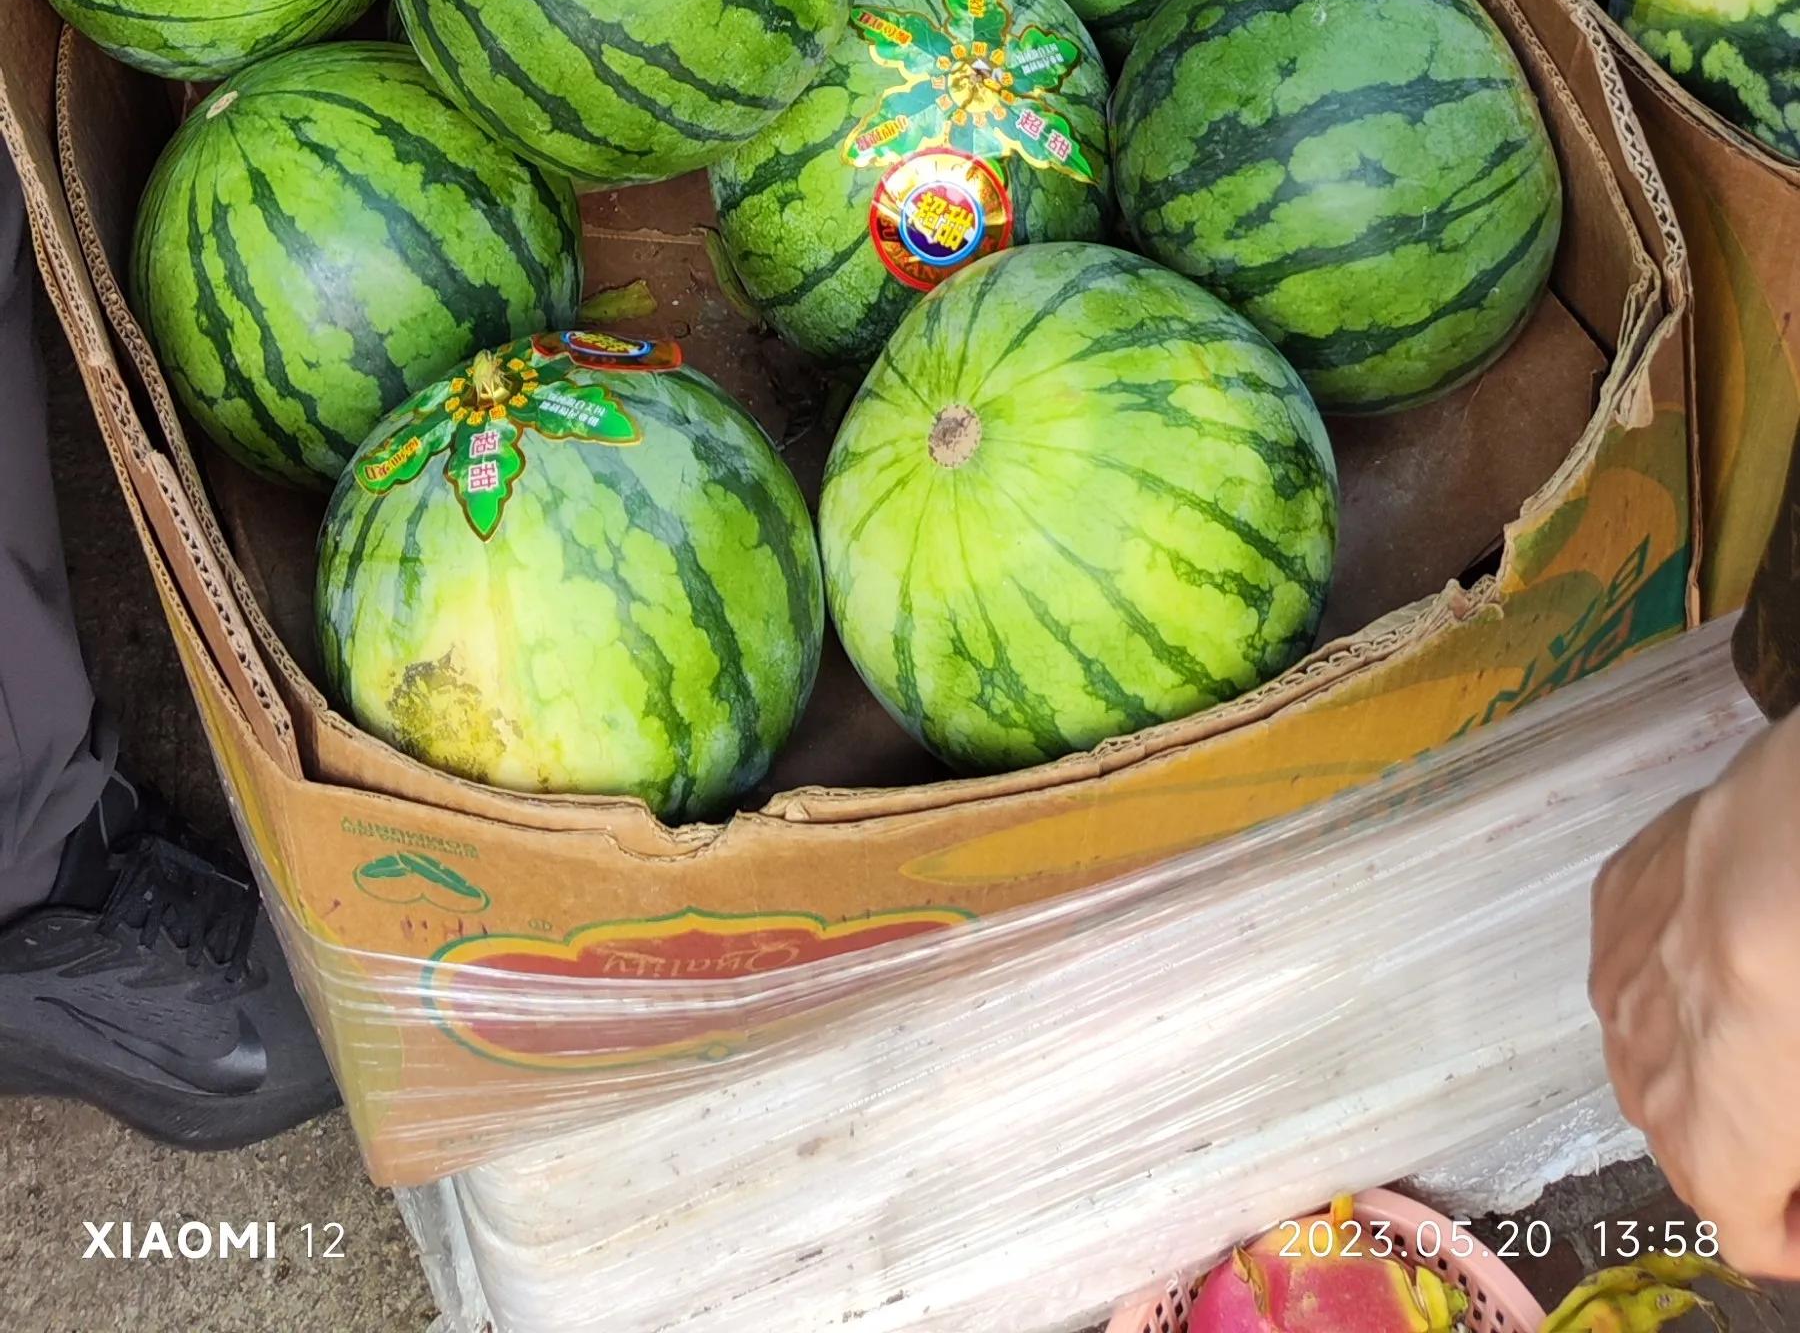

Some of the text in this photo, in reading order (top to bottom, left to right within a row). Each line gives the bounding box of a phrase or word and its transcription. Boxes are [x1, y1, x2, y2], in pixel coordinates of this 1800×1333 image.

[1015, 108, 1072, 162] 超甜
[911, 191, 975, 251] 超甜
[467, 430, 501, 493] 超甜
[597, 940, 800, 978] Quality
